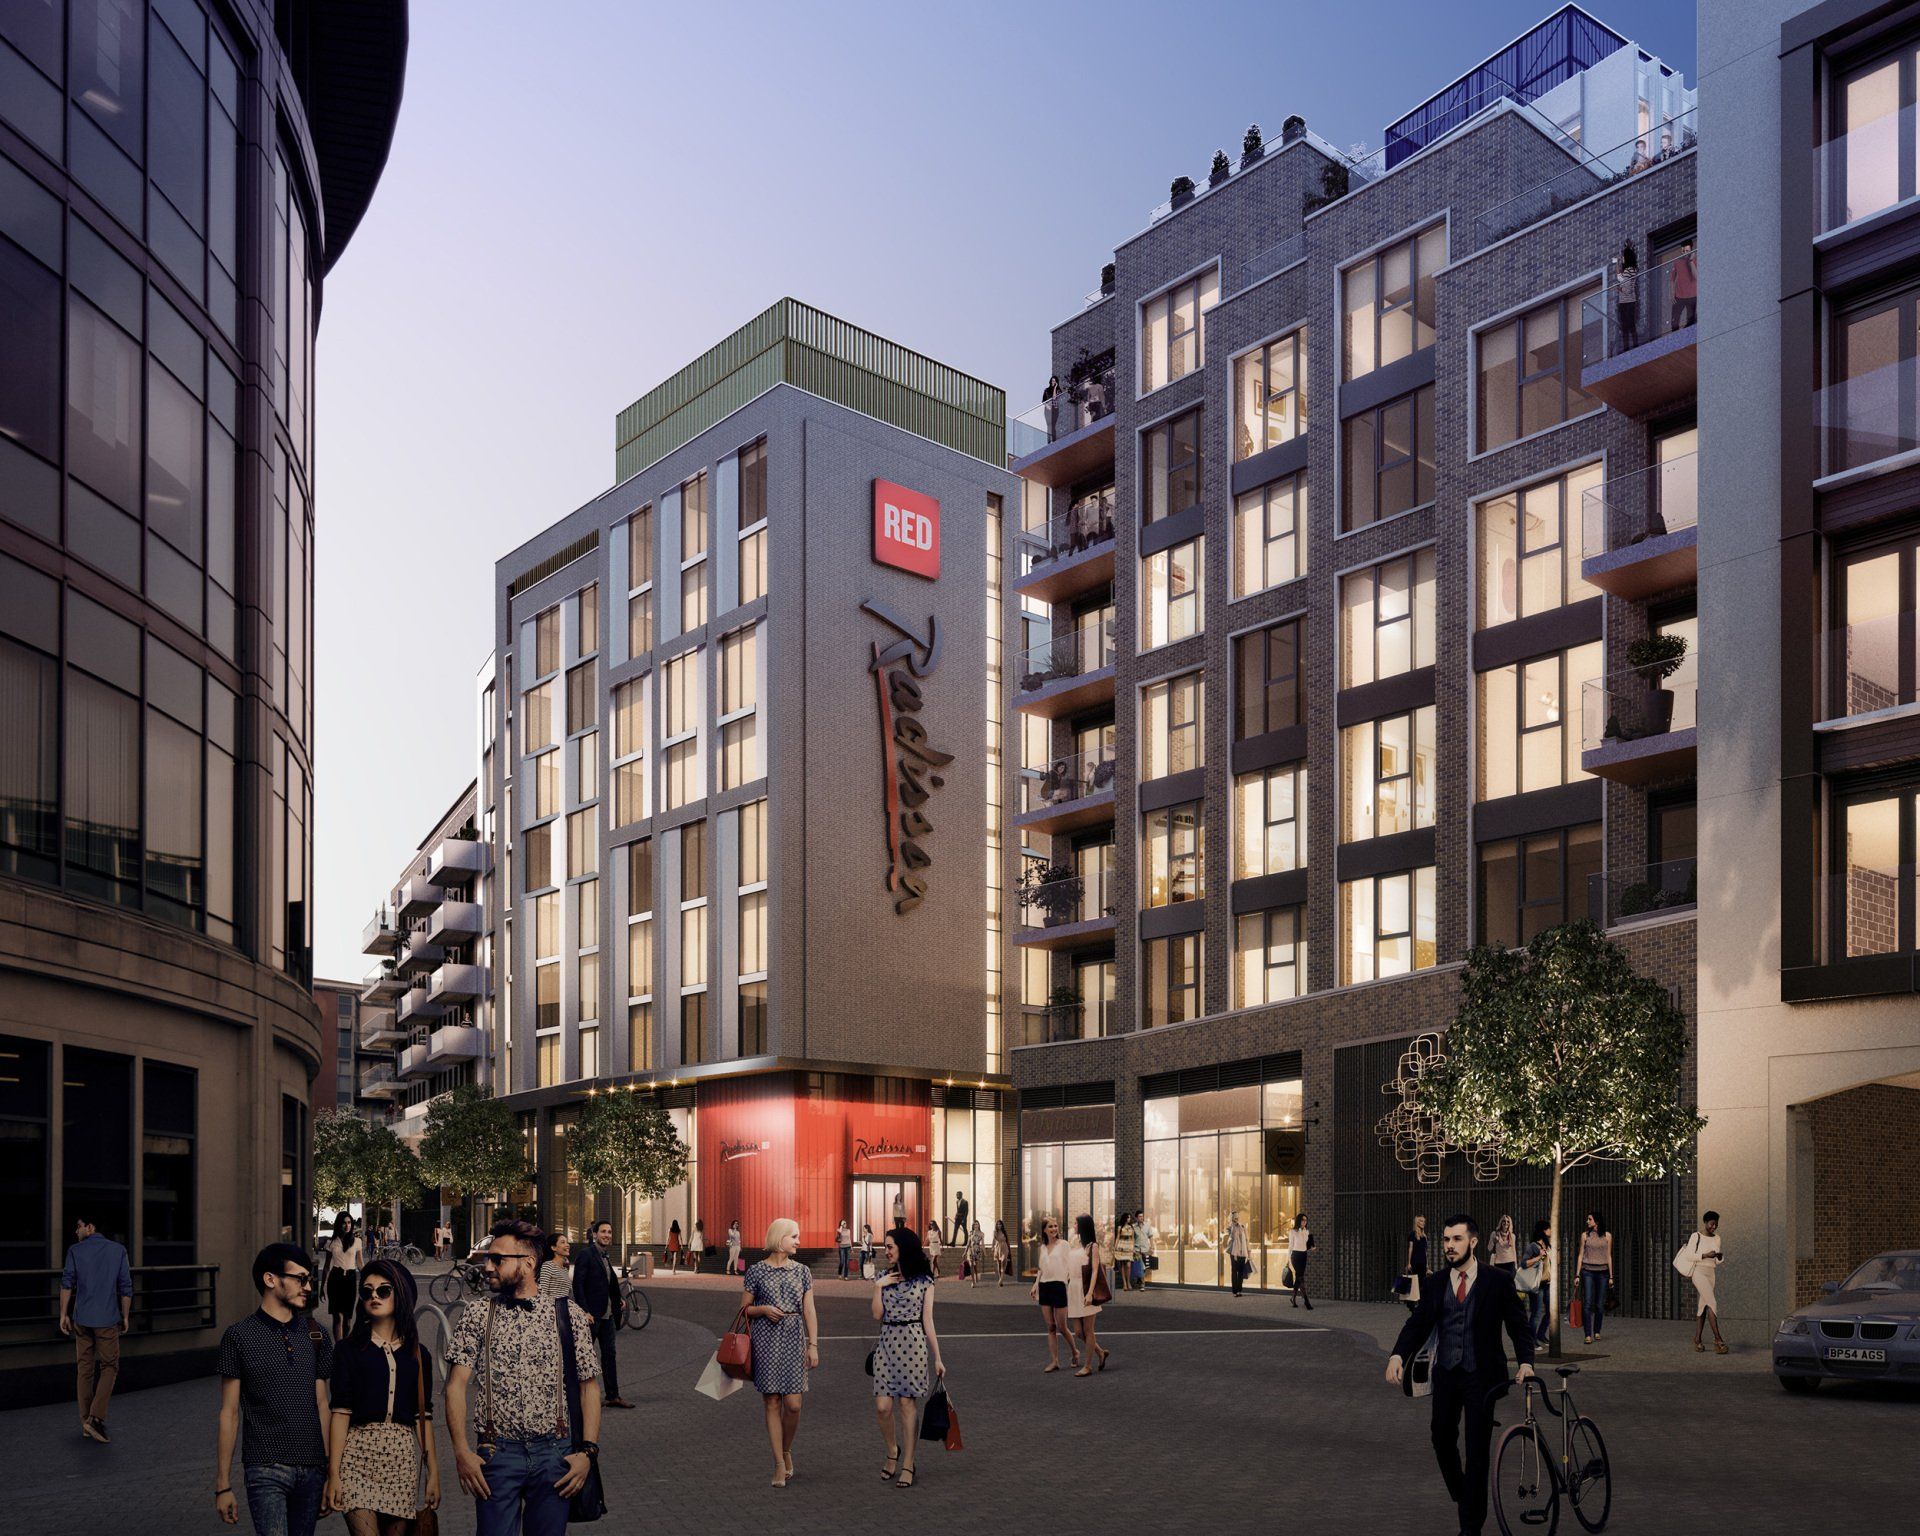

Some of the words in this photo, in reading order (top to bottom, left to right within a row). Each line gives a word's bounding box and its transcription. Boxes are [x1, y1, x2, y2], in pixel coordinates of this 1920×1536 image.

[884, 503, 932, 550] RED
[861, 598, 956, 915] Radisson
[855, 1136, 914, 1162] Radisson
[1830, 1348, 1858, 1359] BP54
[1861, 1350, 1883, 1360] AGS
